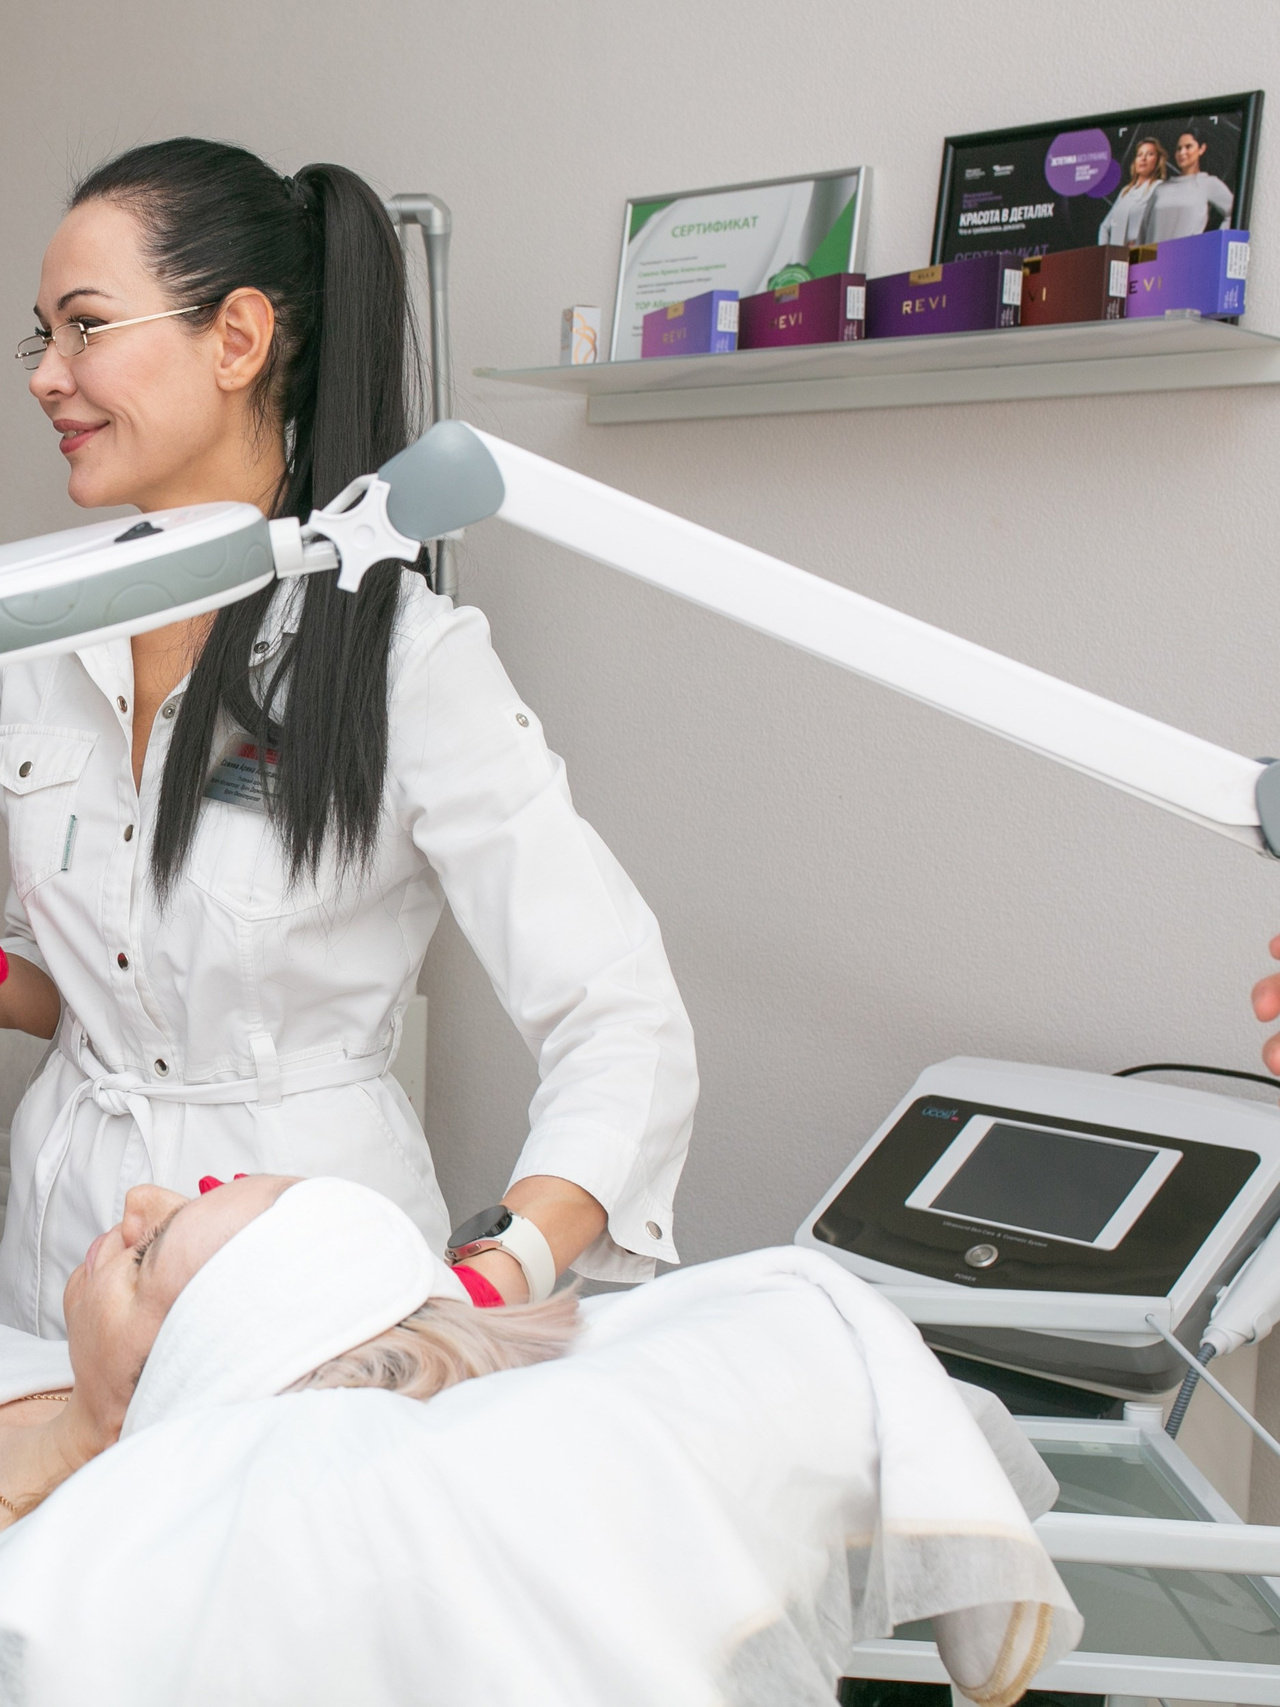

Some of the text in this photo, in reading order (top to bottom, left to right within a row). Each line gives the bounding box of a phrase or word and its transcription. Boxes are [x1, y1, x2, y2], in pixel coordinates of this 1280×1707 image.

[959, 202, 1055, 227] КРАСОТА В ДЕТАЛЯХ
[671, 215, 759, 238] СЕРТИФИКАТ
[1129, 275, 1163, 295] EVI
[902, 294, 947, 315] REVI
[954, 1272, 977, 1283] POWER
